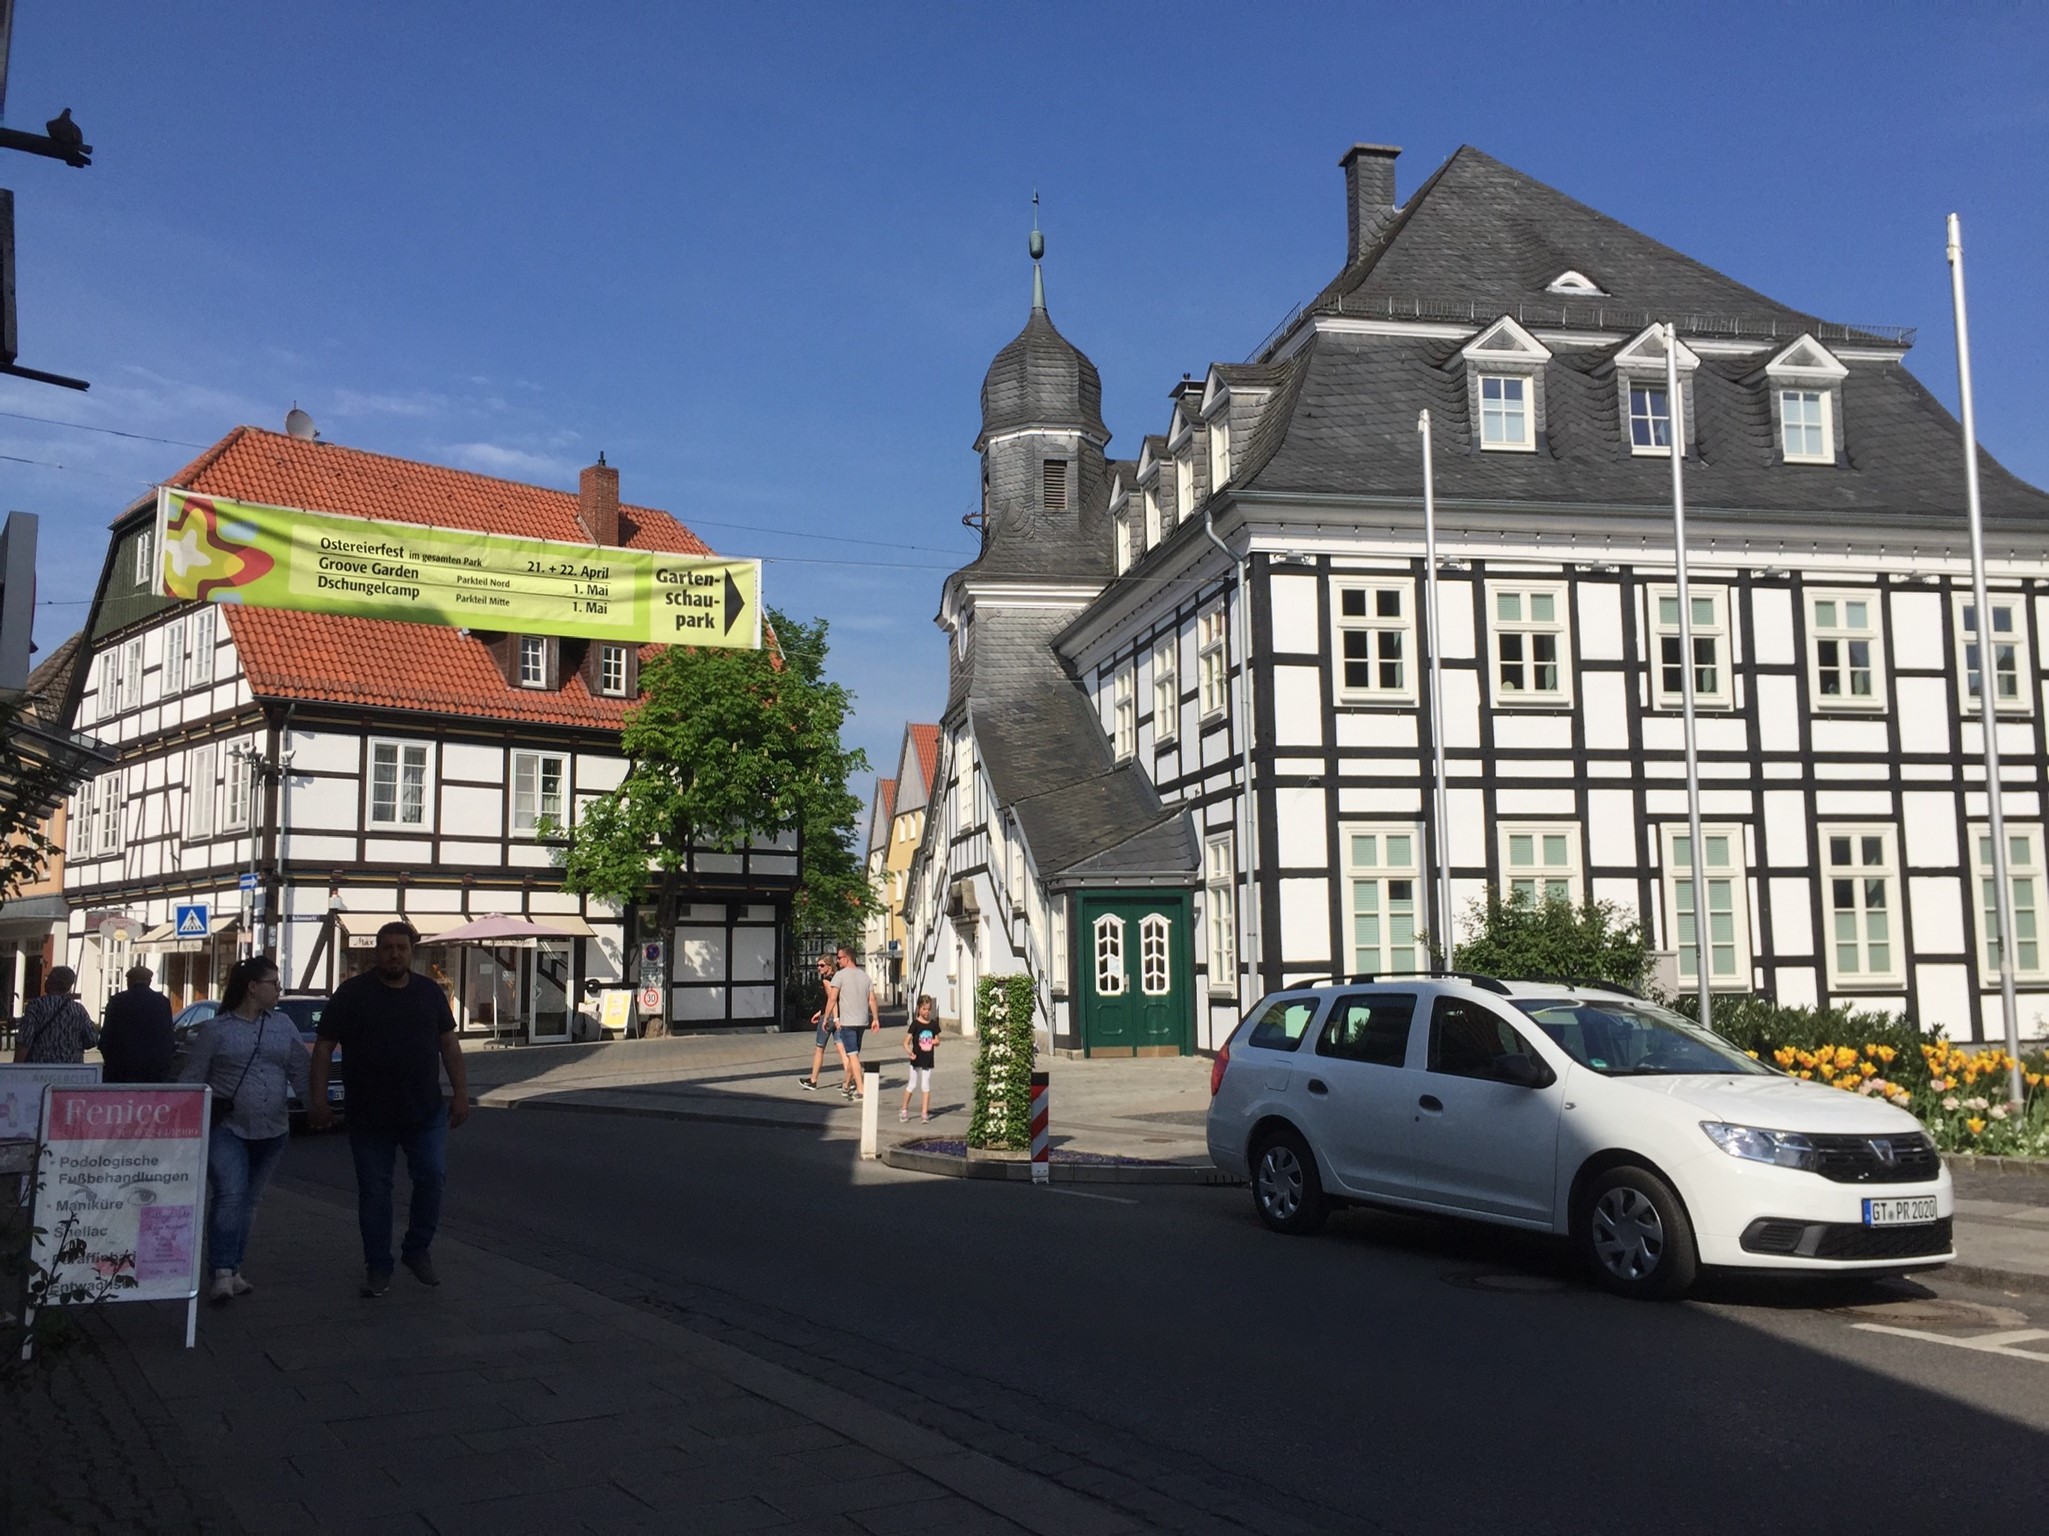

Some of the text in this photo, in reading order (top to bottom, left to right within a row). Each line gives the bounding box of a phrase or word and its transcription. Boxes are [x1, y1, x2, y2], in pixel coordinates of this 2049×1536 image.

[320, 537, 609, 580] Ostereierfest im gesamten Park 21. + 22. April
[319, 557, 608, 596] Groove Garden Parkteil Nord 1. Mai
[656, 568, 721, 586] Garten-
[318, 575, 607, 614] Dschungelcamp Parkteil Mitte 1. Mai
[665, 589, 720, 607] schau-
[676, 612, 715, 631] park
[647, 993, 656, 1003] 30
[64, 1098, 171, 1126] Fenice
[59, 1155, 159, 1169] Podologische
[59, 1172, 189, 1185] Fußbehandlungen
[56, 1198, 124, 1212] Maniküre
[1872, 1200, 1935, 1221] GT PR 2020
